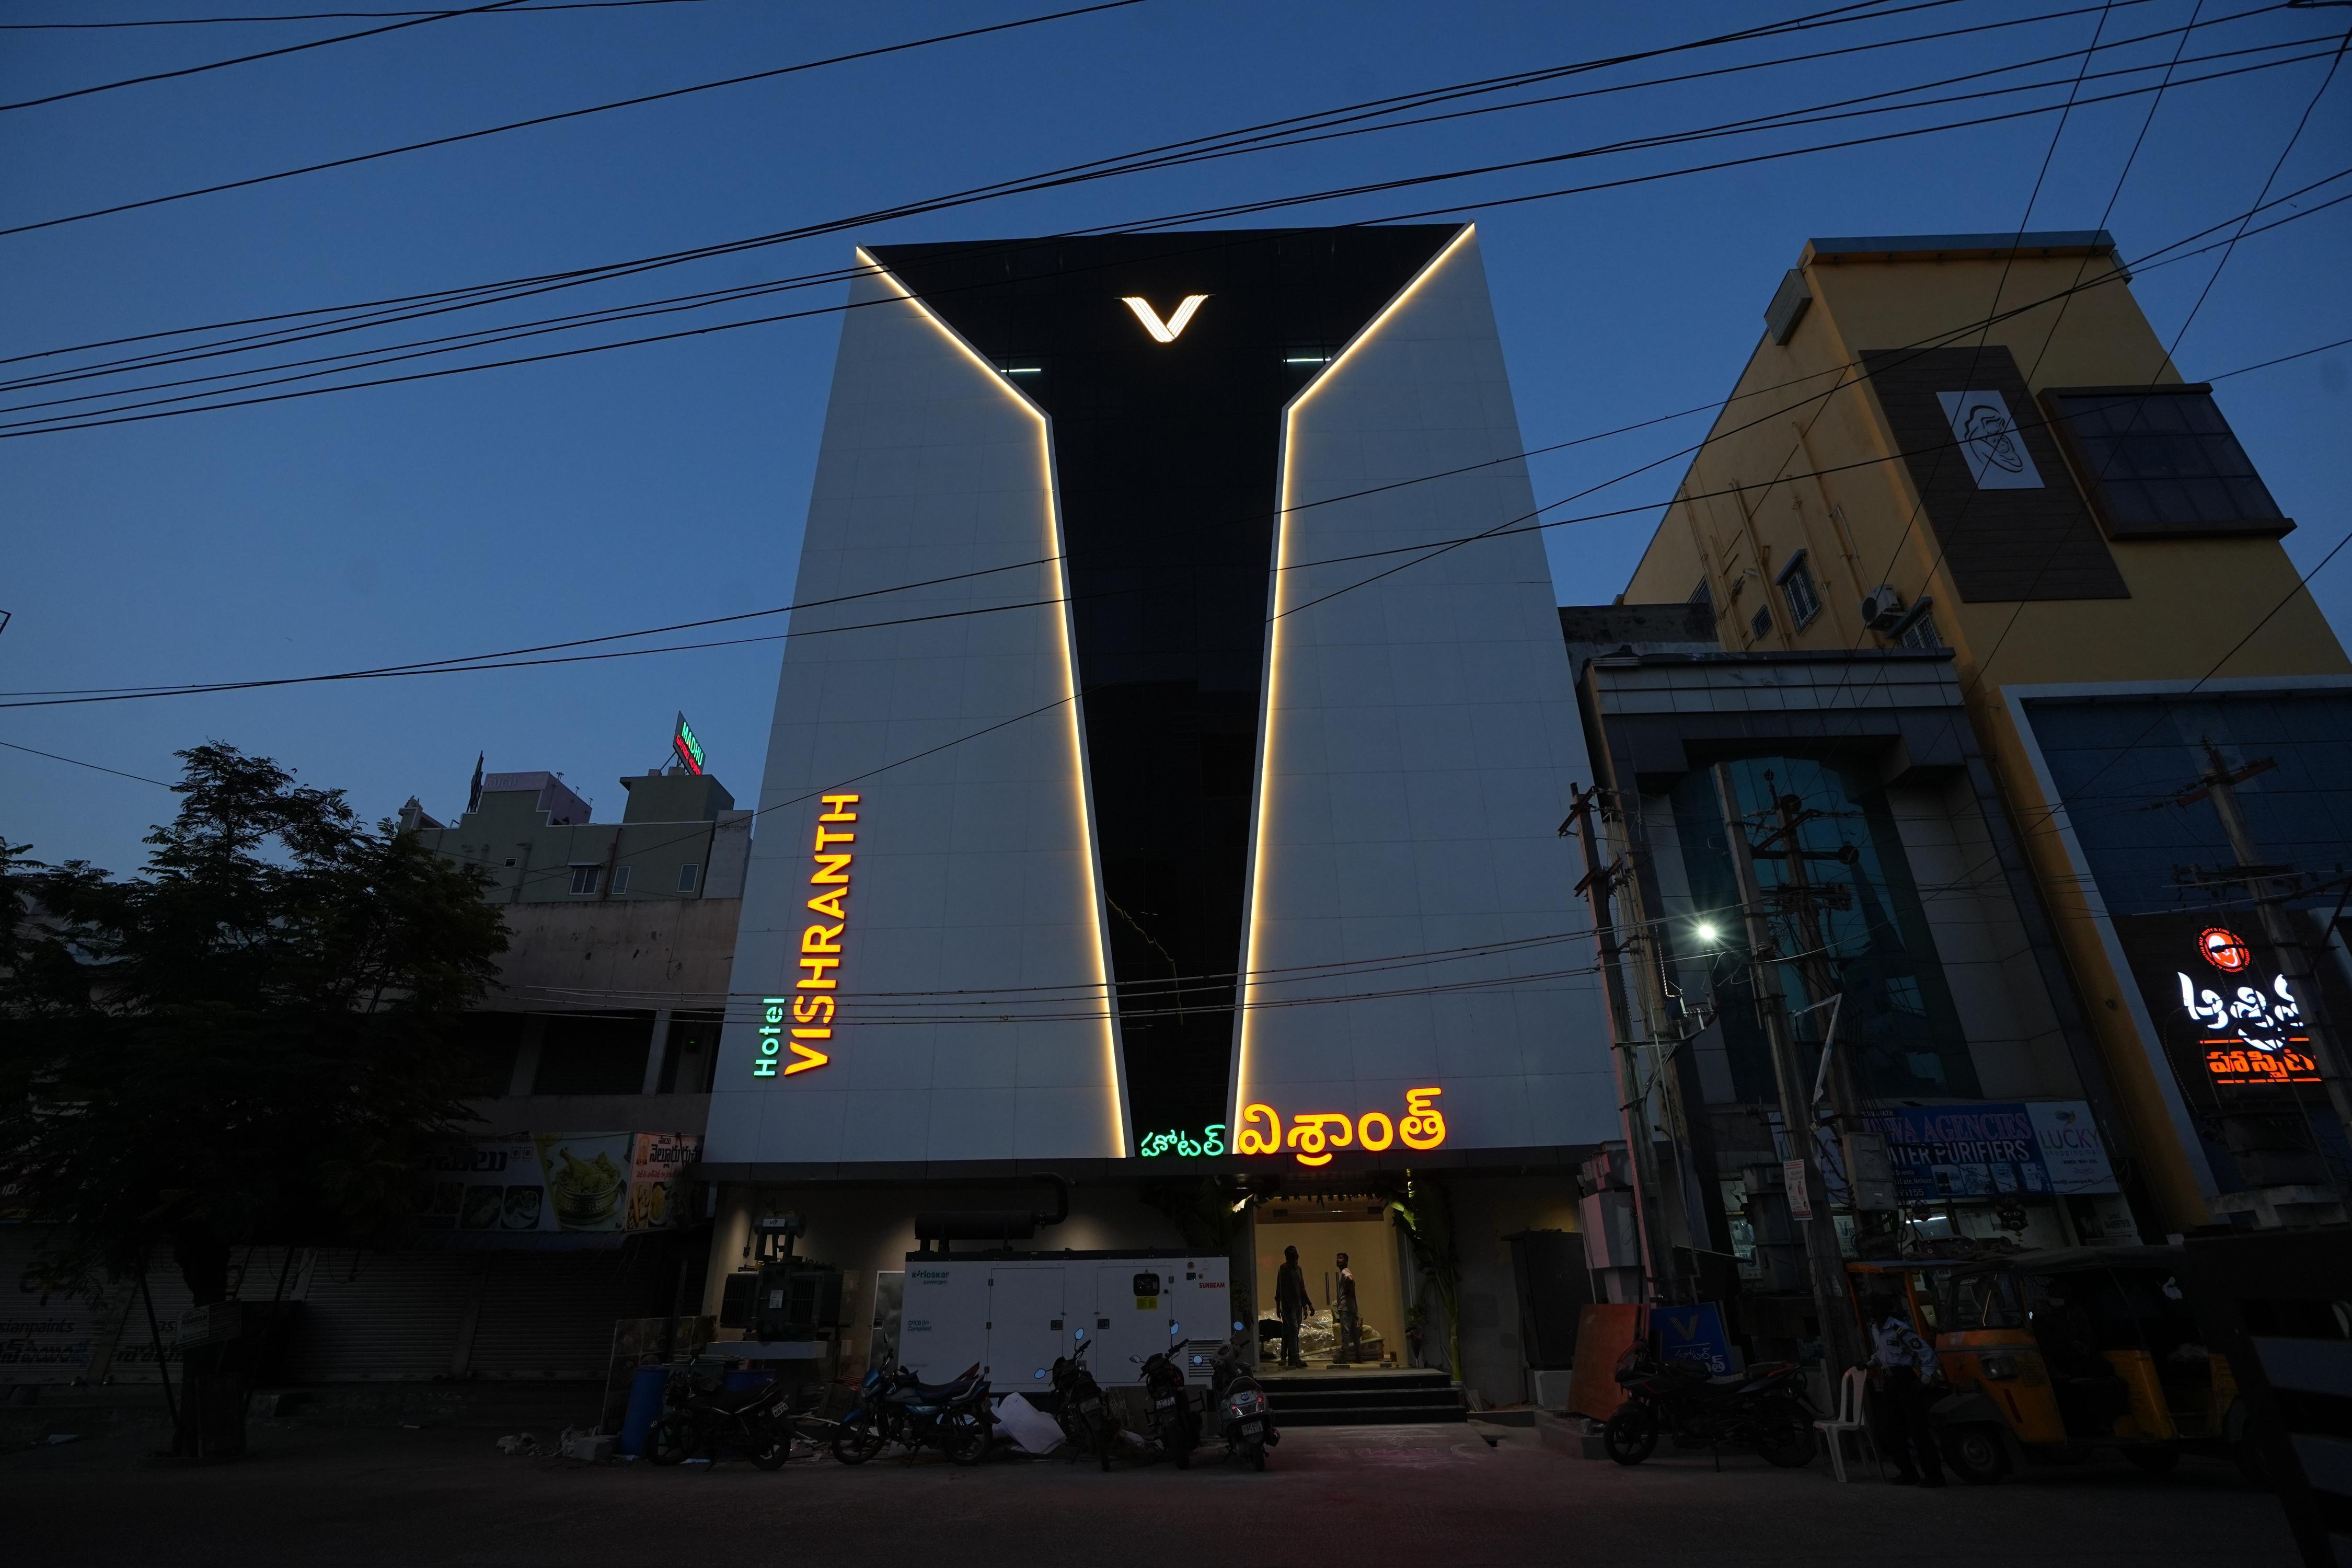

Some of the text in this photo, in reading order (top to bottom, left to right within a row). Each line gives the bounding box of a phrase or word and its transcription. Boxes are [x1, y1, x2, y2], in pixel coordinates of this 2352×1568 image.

[675, 734, 690, 760] GASTRO
[681, 721, 704, 766] MADHU
[783, 794, 860, 1077] VISHRANTH
[753, 996, 786, 1078] Hotel
[2206, 1048, 2316, 1078] హాస్పిట
[1140, 1087, 1447, 1167] హోటల్ విశ్రాంత్
[1924, 1112, 2033, 1142] AGENCIES
[2038, 1128, 2099, 1149] LUCKY
[1886, 1144, 1932, 1167] ATER
[1933, 1139, 2031, 1164] PURIFIERS
[0, 1318, 76, 1338] sianpaints
